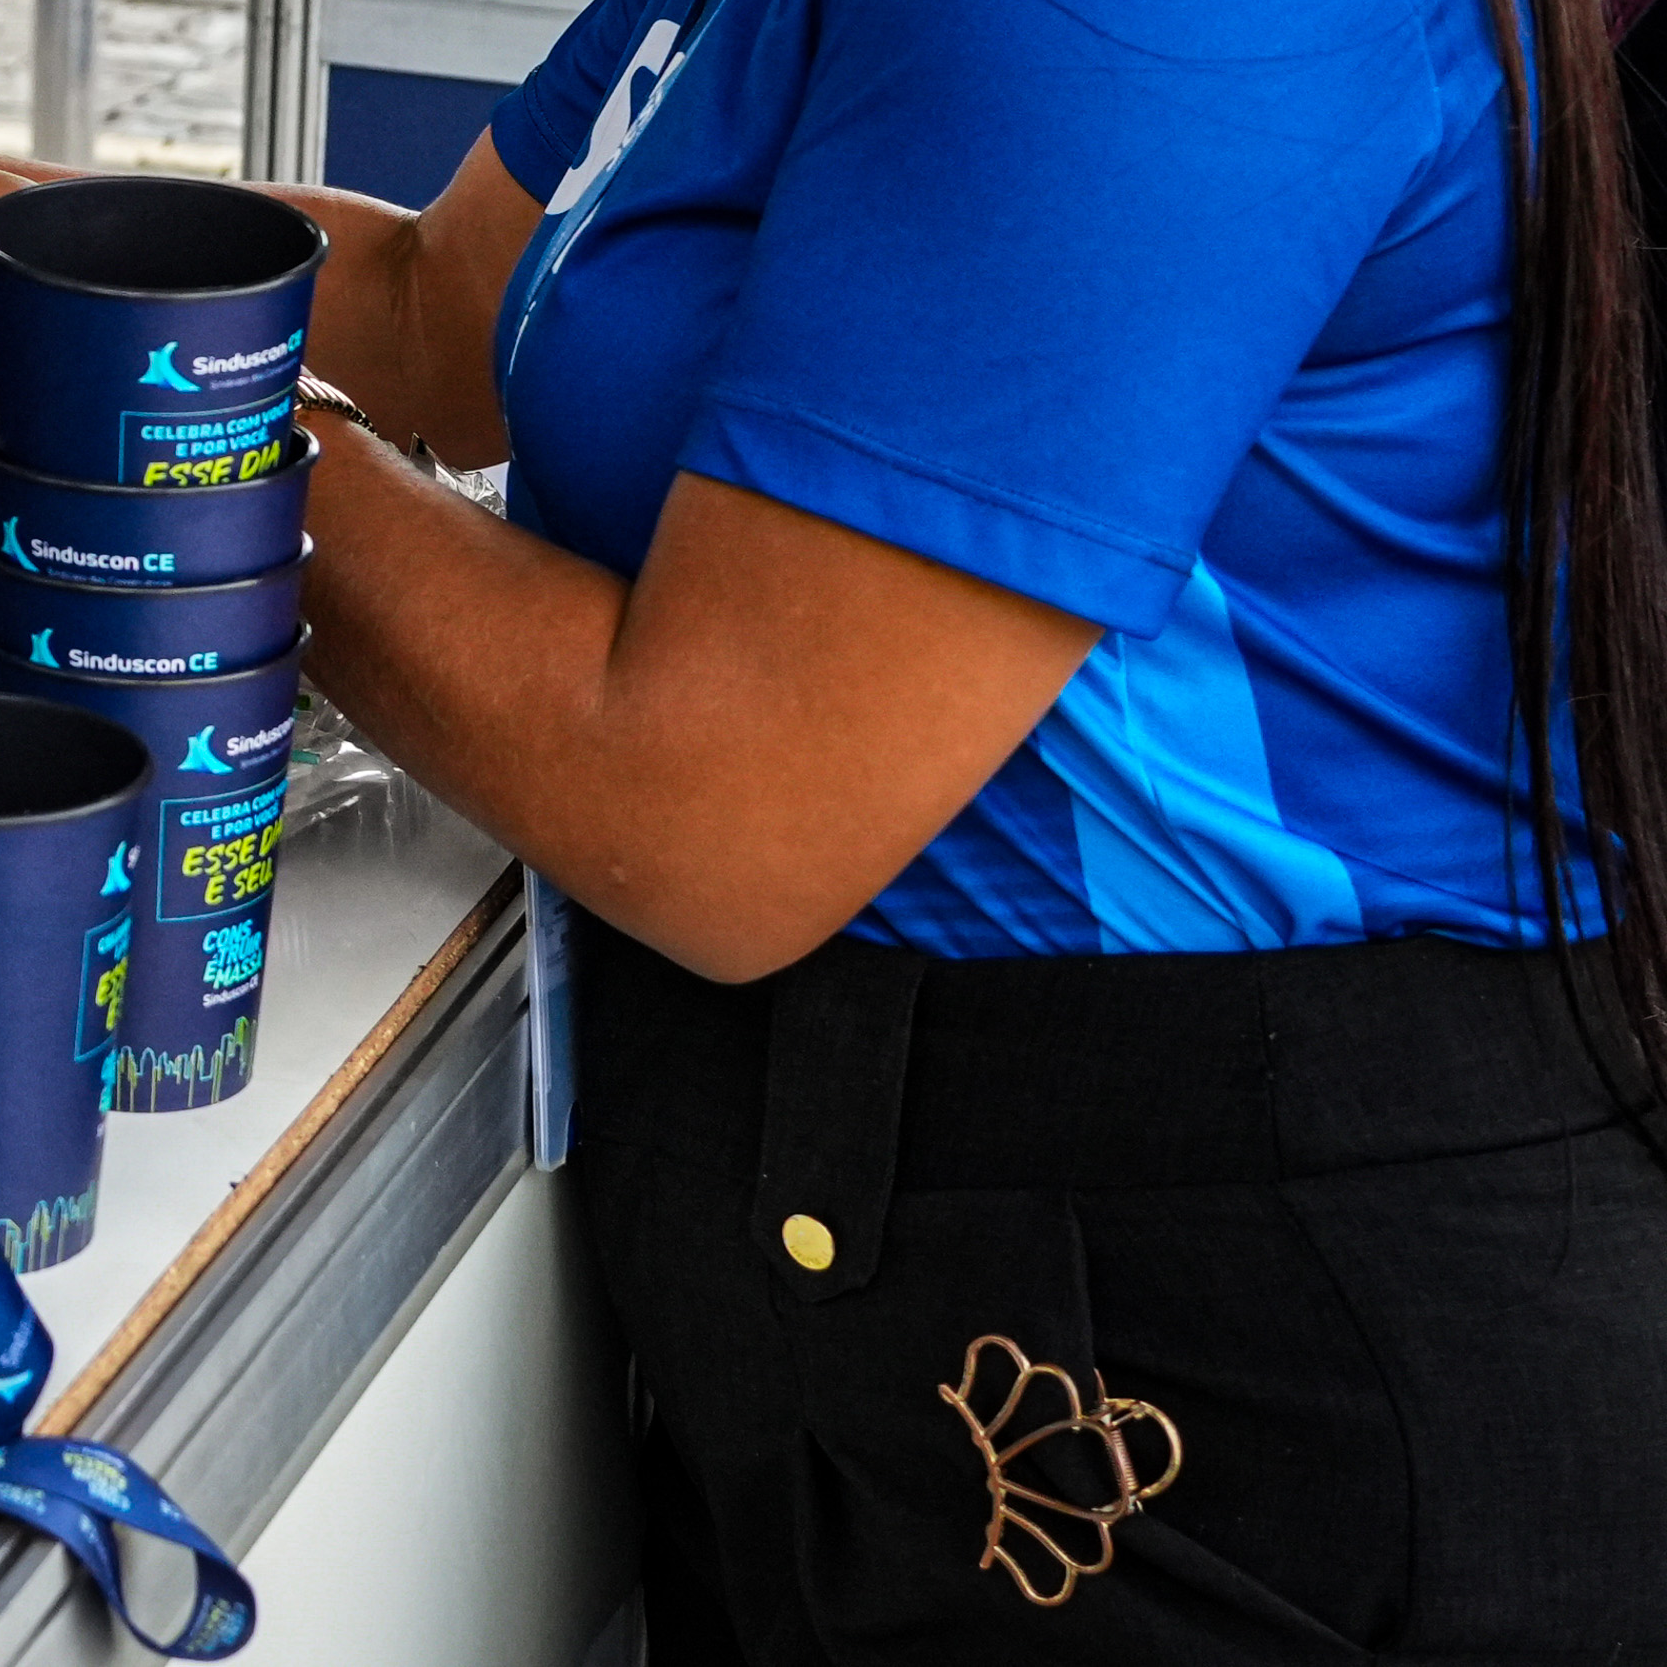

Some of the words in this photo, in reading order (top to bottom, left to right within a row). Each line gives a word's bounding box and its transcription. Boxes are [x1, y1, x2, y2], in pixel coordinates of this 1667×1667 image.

[192, 342, 288, 376] Sinduscon
[140, 421, 225, 441] CELEBRA
[225, 413, 261, 435] COM
[175, 442, 189, 459] E
[190, 437, 228, 457] POR
[30, 538, 140, 573] Sinduscon
[142, 552, 176, 573] CE
[68, 648, 186, 674] Sinduscon
[188, 651, 219, 672] CE
[180, 800, 252, 827] CELEBRA
[223, 816, 254, 837] POR
[181, 833, 257, 877] ESSE
[232, 857, 274, 901] SEU
[202, 918, 254, 954] CONS
